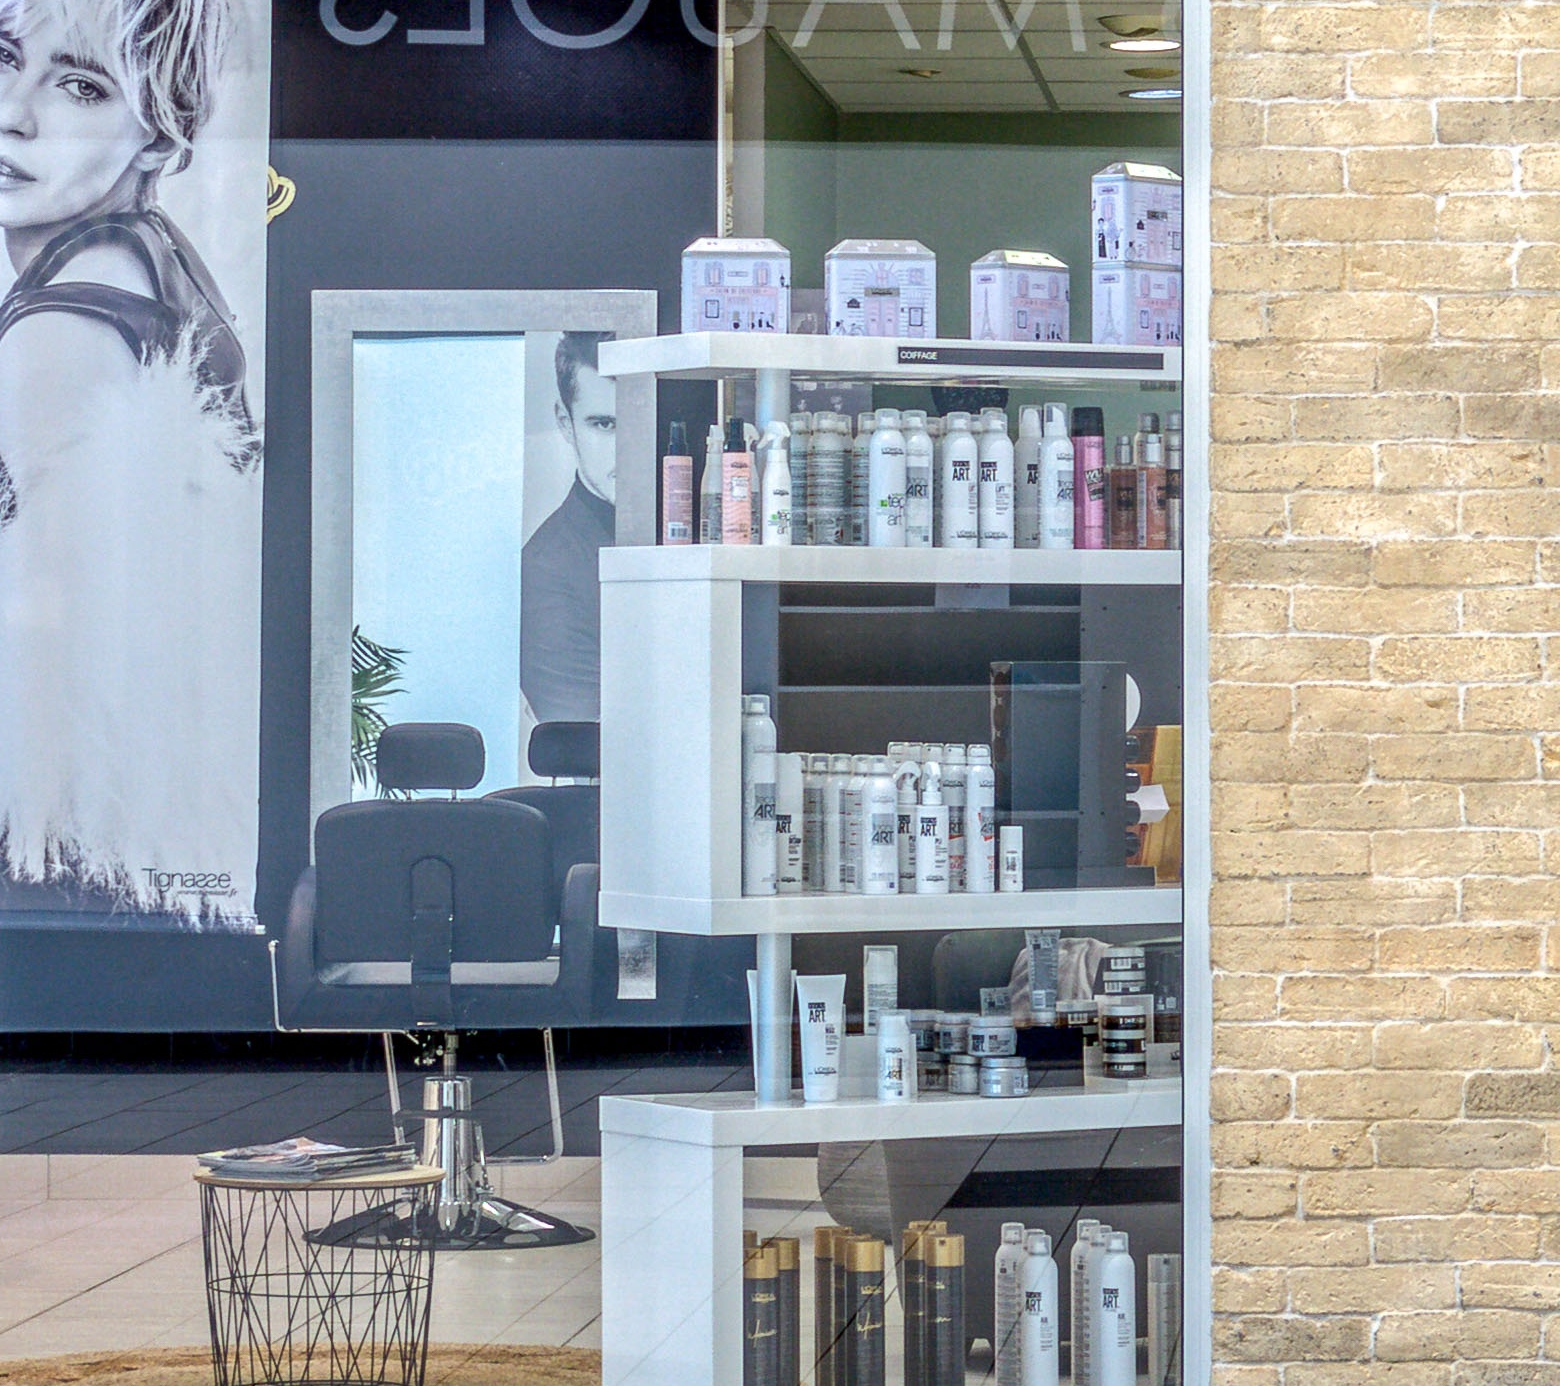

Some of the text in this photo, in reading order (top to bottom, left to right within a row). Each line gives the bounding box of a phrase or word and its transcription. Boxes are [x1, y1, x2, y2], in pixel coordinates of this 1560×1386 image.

[899, 350, 938, 361] COIFFAGE
[141, 867, 231, 893] Tignasse
[809, 1010, 826, 1023] ART
[1025, 1299, 1042, 1312] ART
[1103, 1295, 1119, 1308] ART
